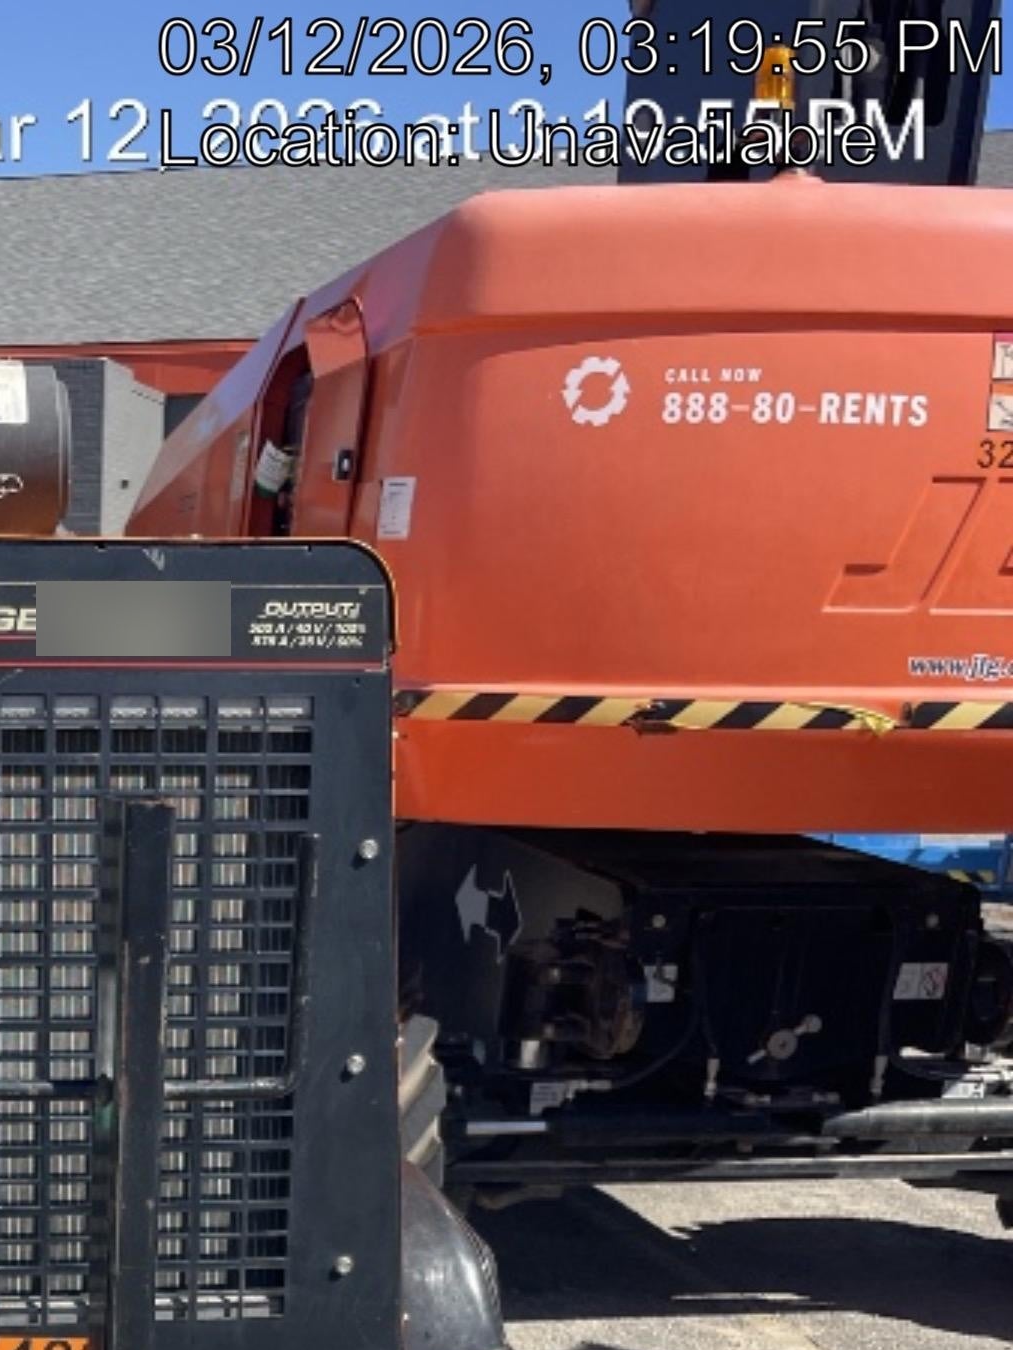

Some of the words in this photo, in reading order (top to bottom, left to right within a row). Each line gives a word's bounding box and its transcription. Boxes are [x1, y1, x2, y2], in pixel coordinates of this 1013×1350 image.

[664, 369, 711, 383] CALL
[720, 369, 763, 382] NOW
[662, 392, 929, 427] 888-80-RENTS
[264, 601, 356, 617] OUTPUT
